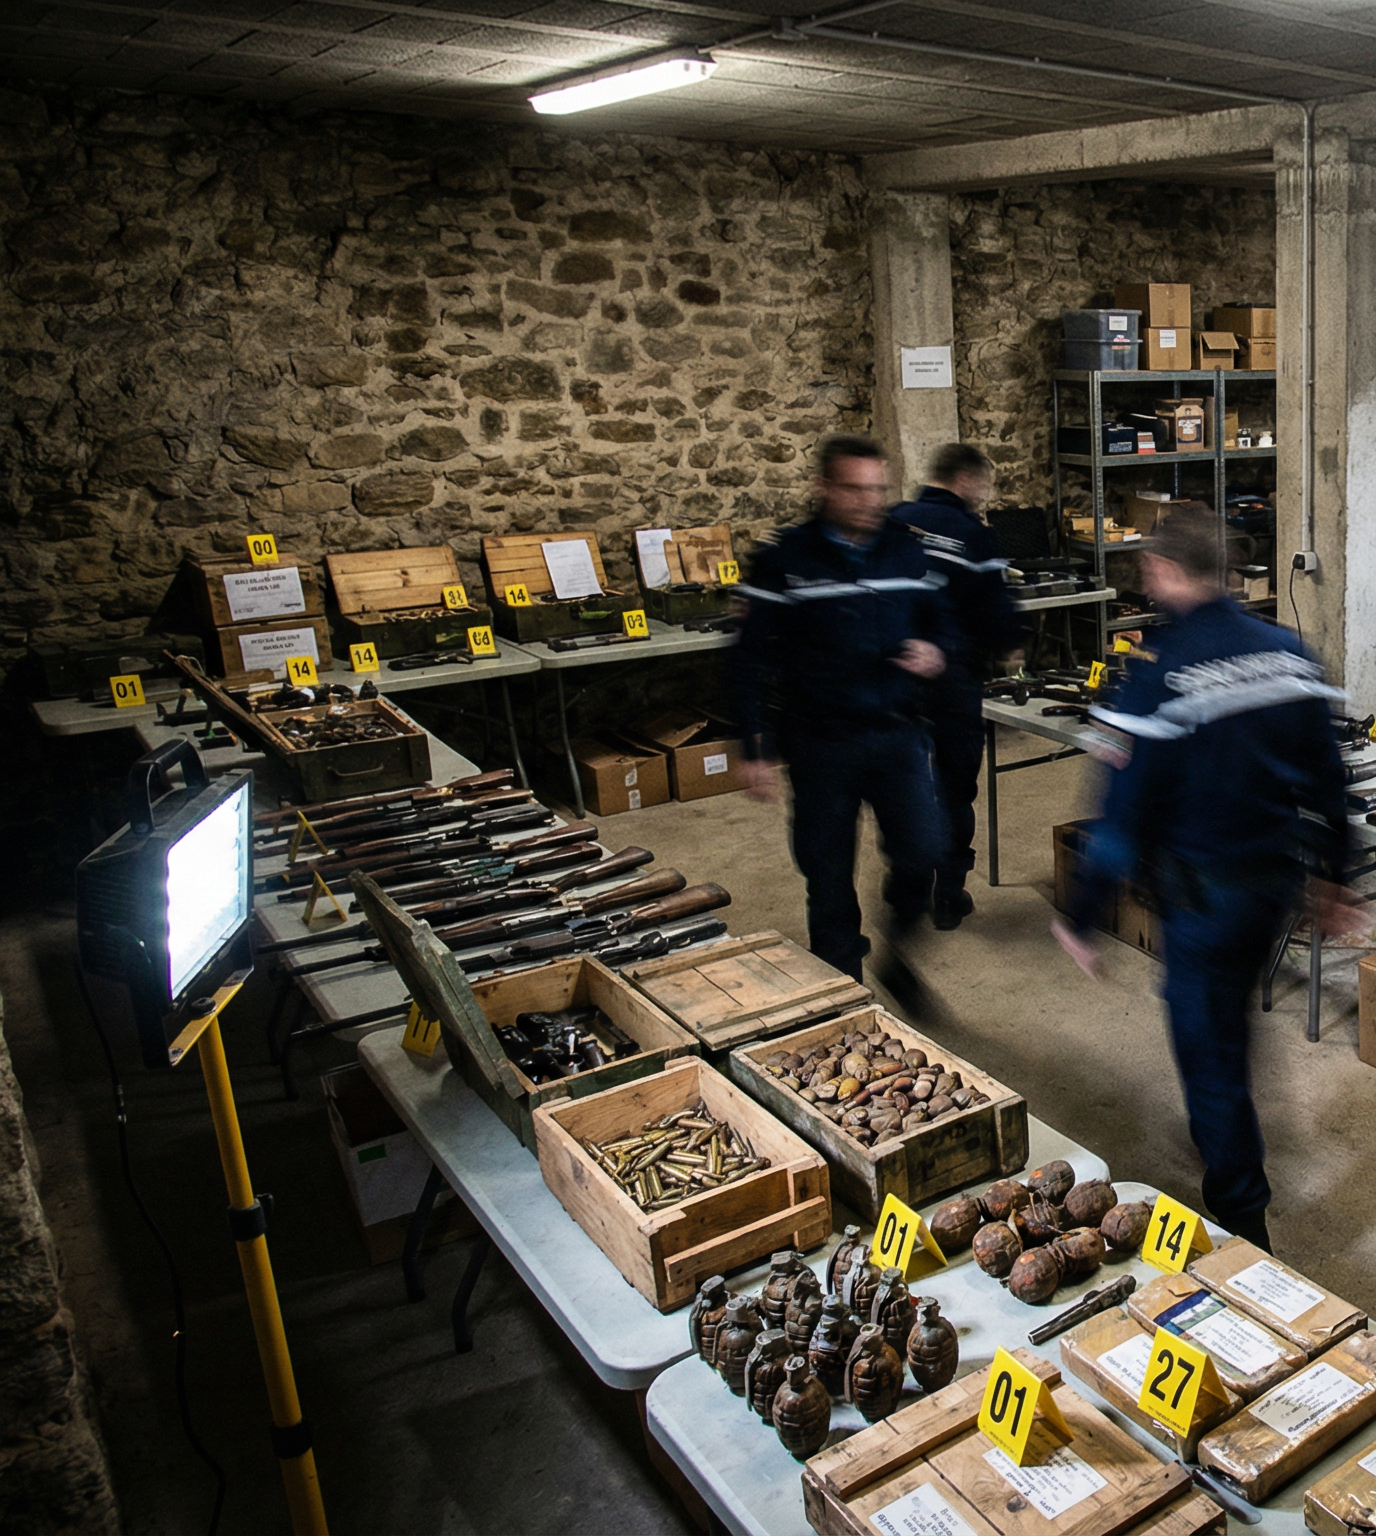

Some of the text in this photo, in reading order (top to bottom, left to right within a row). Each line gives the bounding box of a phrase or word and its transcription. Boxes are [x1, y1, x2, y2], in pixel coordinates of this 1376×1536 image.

[253, 539, 273, 556] 00
[509, 589, 526, 603] 14
[354, 648, 374, 665] 14
[293, 660, 311, 679] 14
[115, 681, 138, 699] 01
[880, 1211, 909, 1267] 01
[1155, 1211, 1187, 1261] 14
[1148, 1348, 1196, 1411] 27
[989, 1370, 1028, 1437] 01
